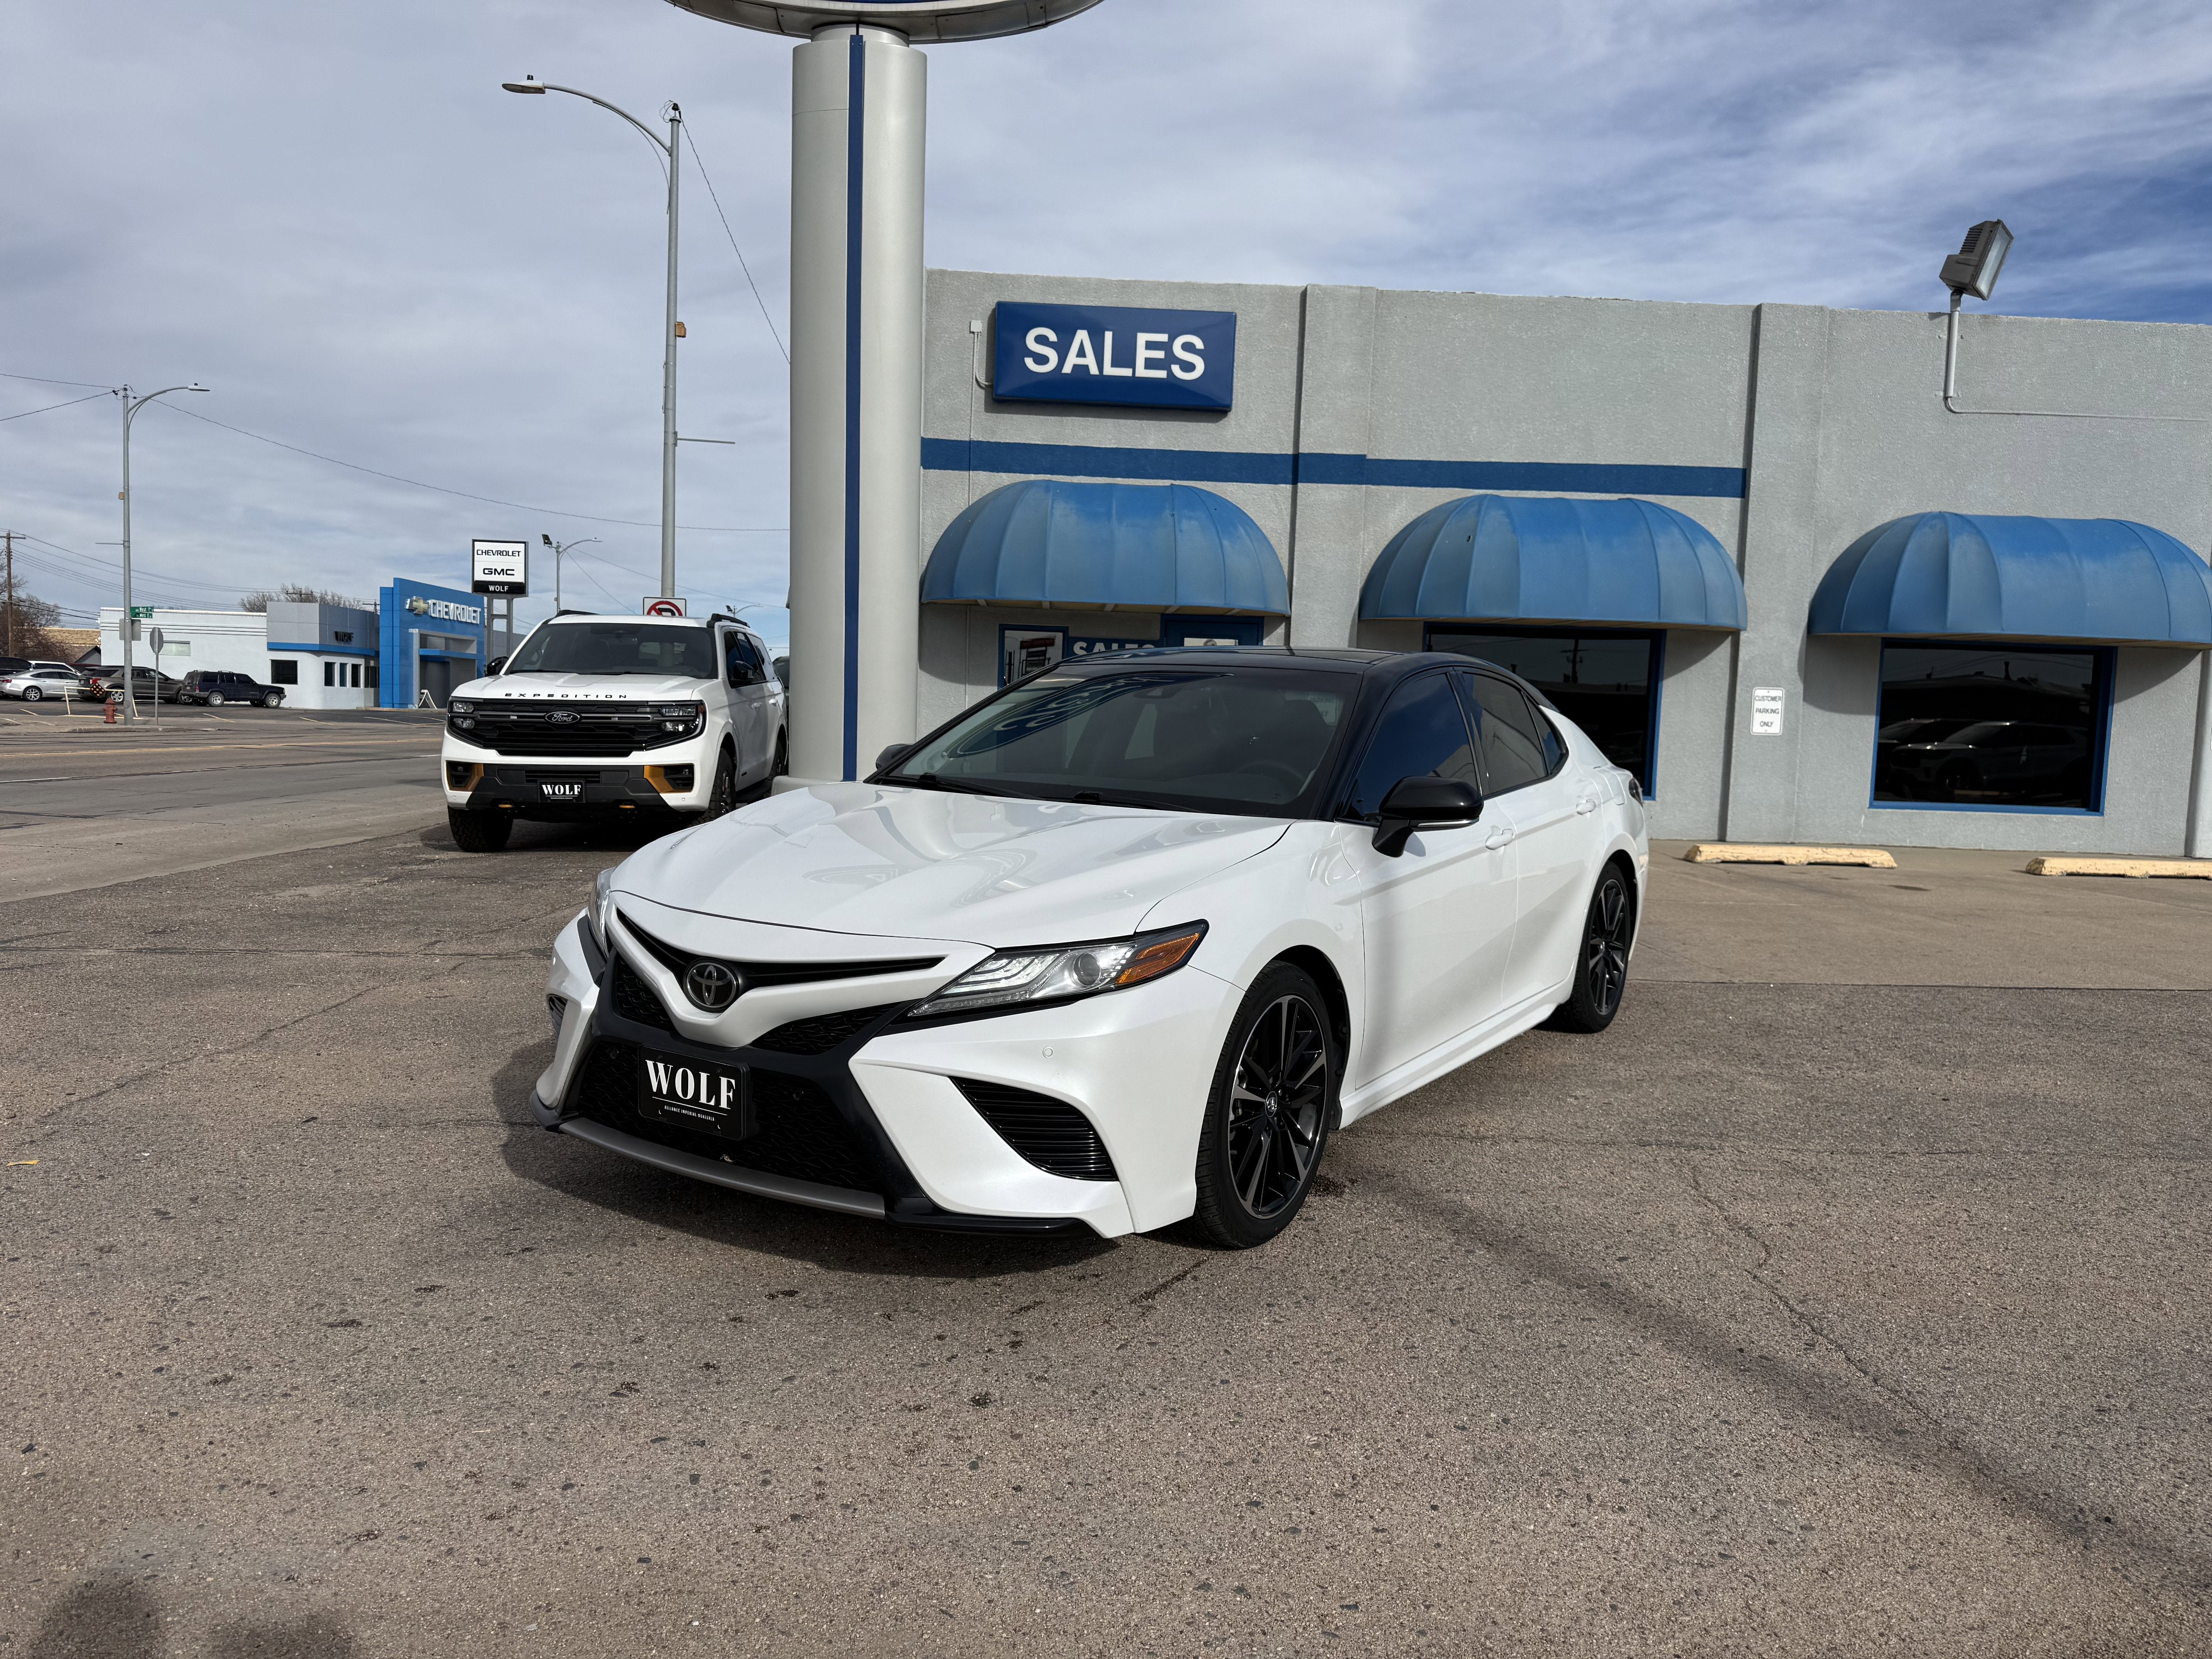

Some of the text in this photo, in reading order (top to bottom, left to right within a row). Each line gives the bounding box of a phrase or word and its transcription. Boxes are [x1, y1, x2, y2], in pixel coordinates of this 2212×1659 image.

[1024, 327, 1205, 380] SALES
[428, 599, 481, 624] CHEVROLET
[335, 631, 354, 642] WOLF
[552, 713, 573, 722] Ford
[542, 785, 581, 795] WOLF
[645, 1060, 735, 1109] WOLF
